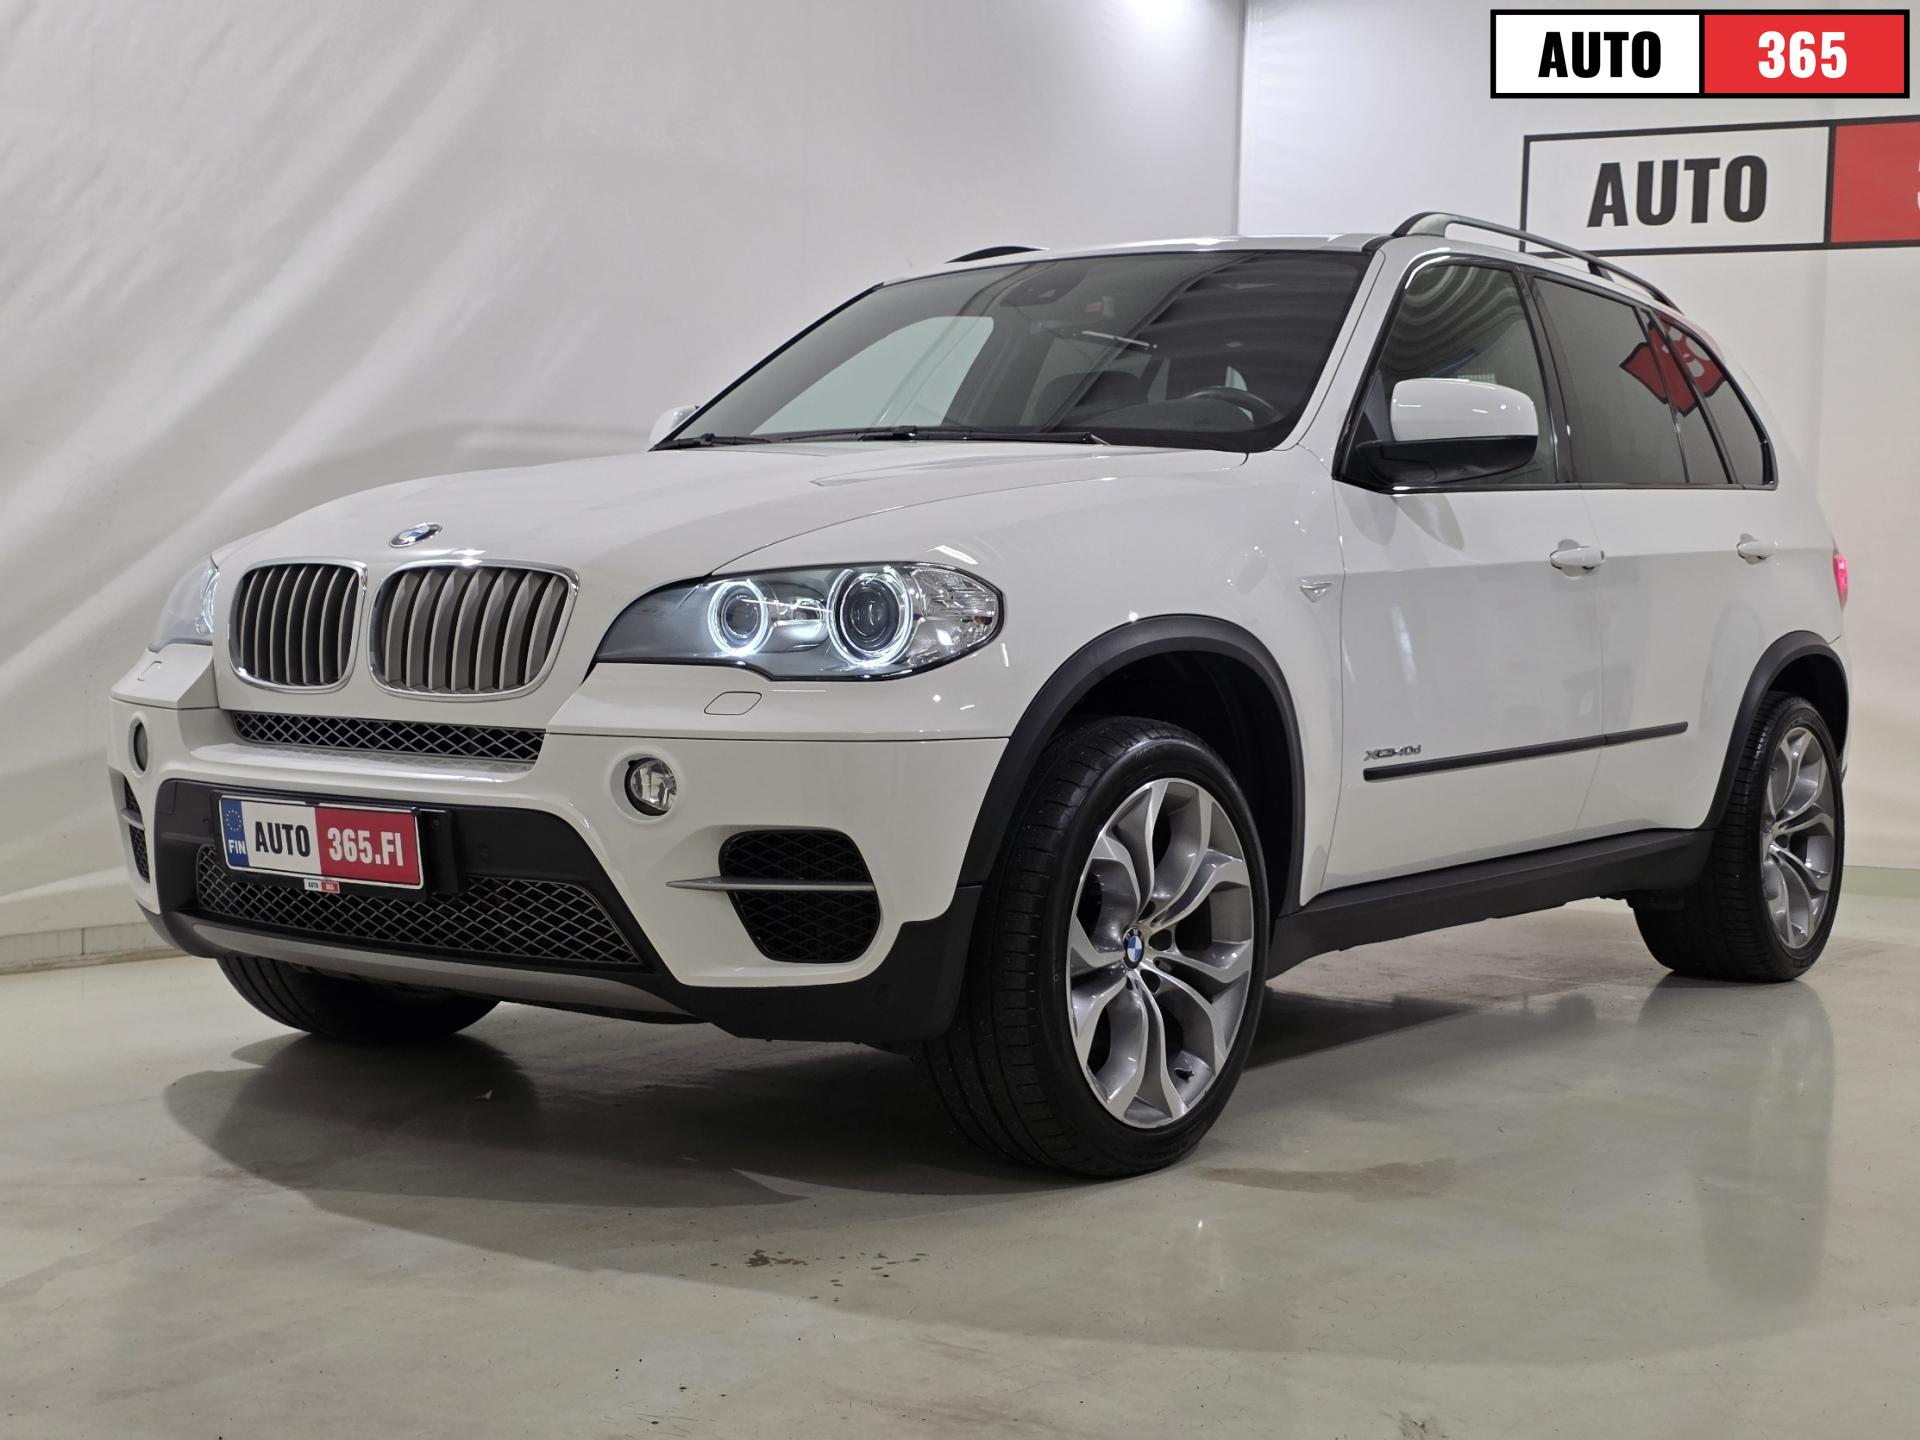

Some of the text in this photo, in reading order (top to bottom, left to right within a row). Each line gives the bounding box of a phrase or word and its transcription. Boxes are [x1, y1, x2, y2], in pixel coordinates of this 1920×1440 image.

[1587, 155, 1767, 228] AUTO
[228, 839, 247, 855] FIN
[255, 821, 404, 867] AUTO 365.FI
